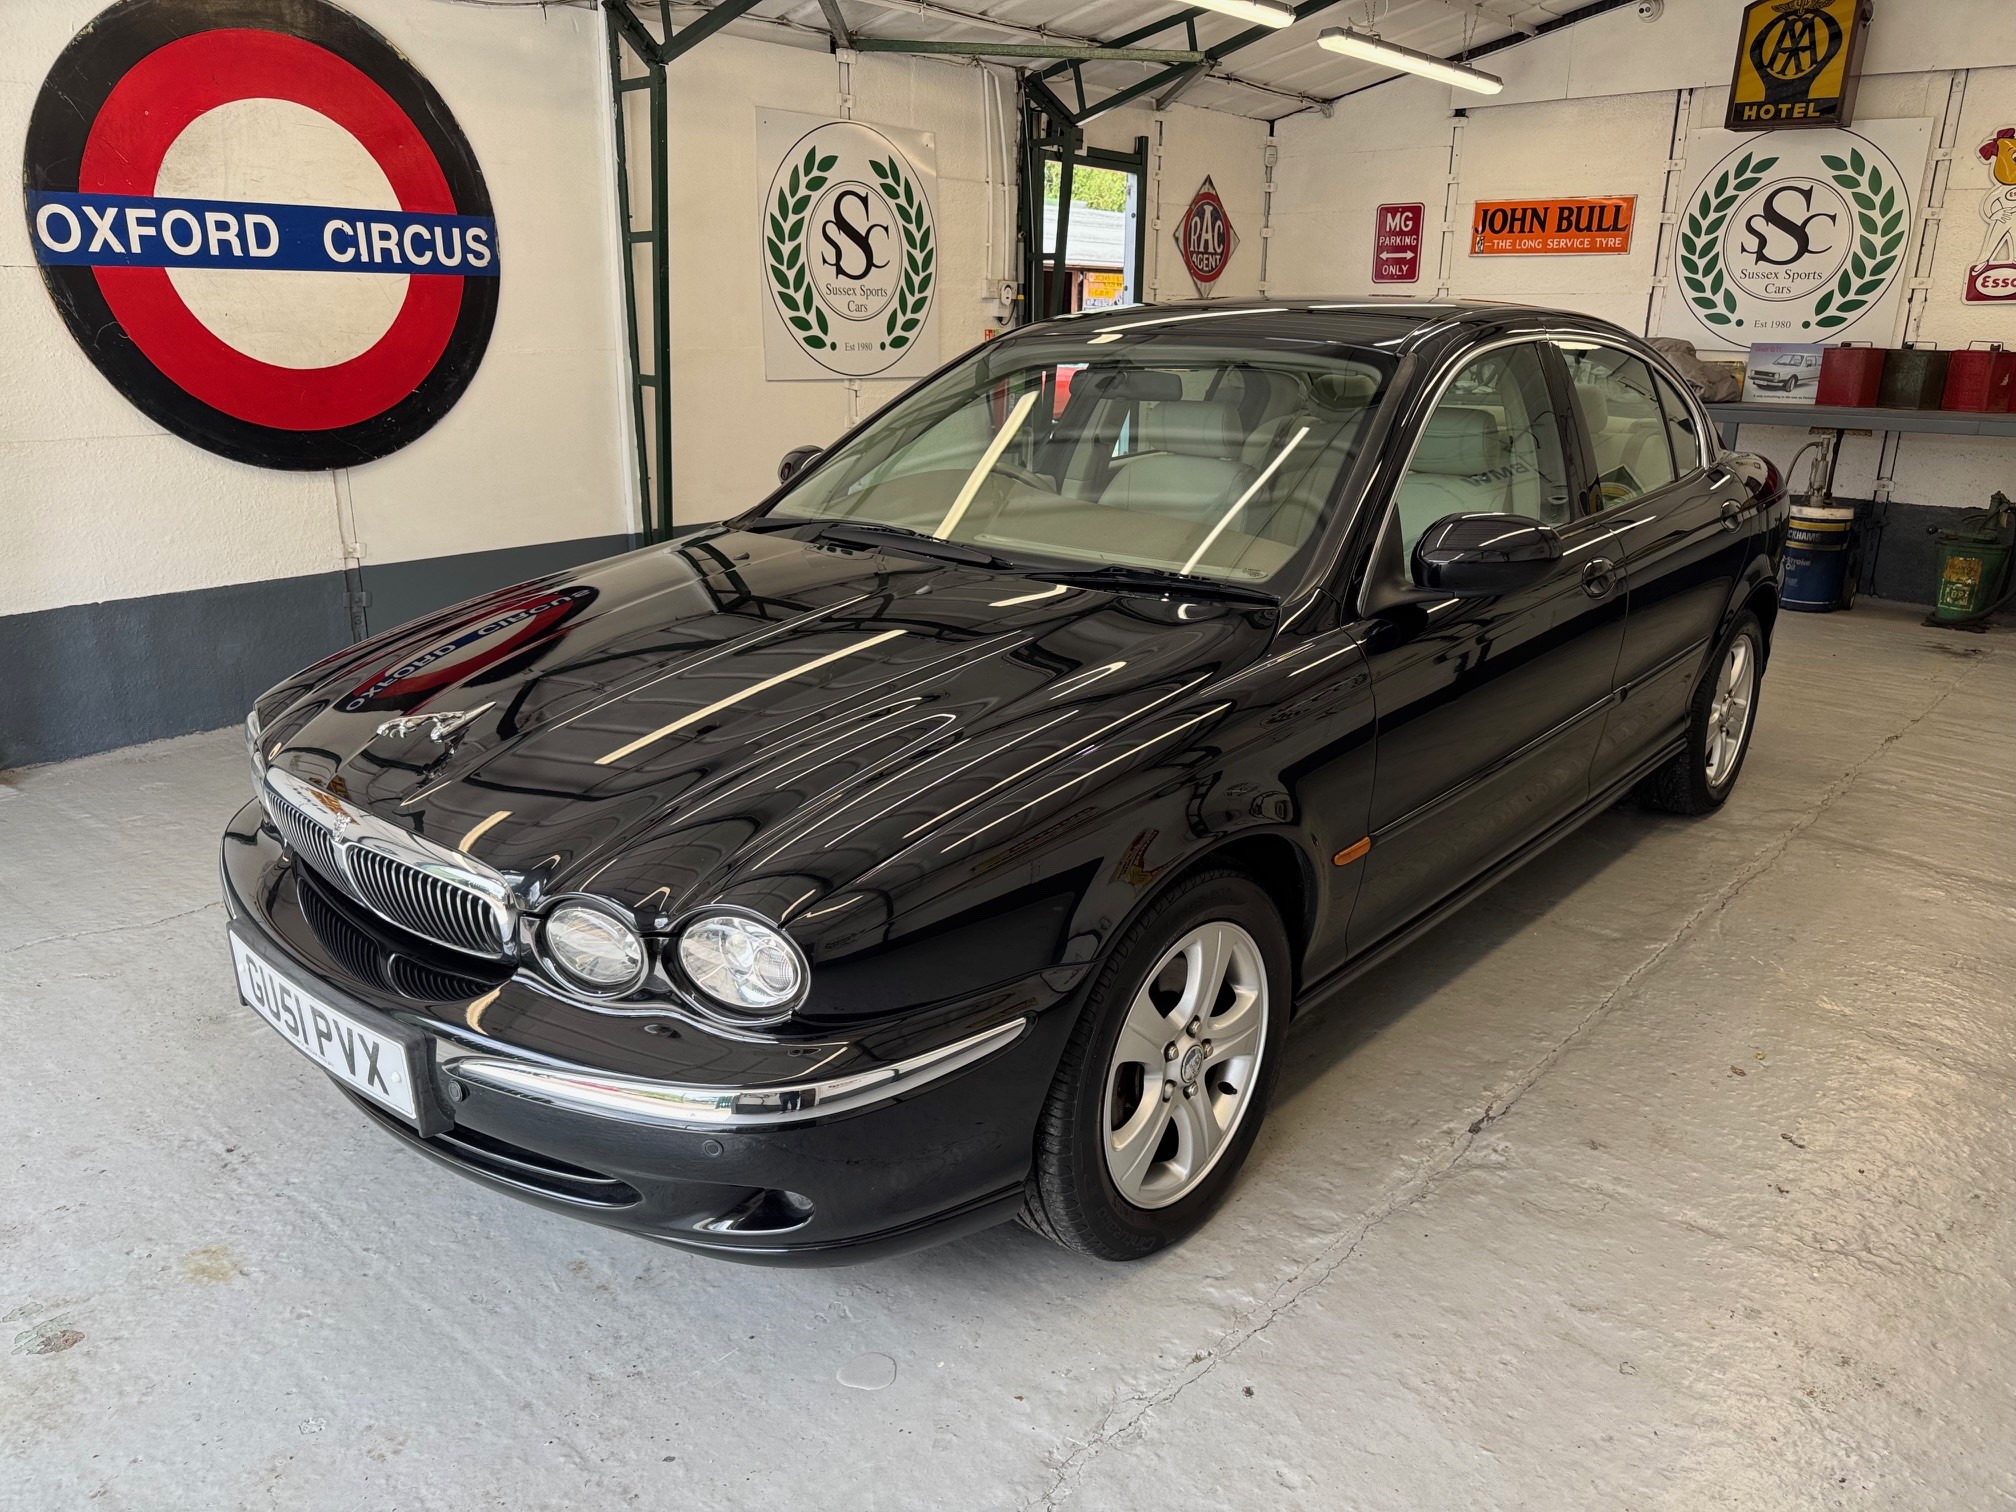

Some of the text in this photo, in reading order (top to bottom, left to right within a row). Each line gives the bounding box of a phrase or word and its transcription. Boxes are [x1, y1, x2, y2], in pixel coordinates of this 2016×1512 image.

[1743, 102, 1820, 120] HOTEL
[1385, 212, 1413, 232] MG
[1474, 204, 1628, 235] JOHN BULL
[36, 203, 493, 267] OXFORD CIRCUS
[1189, 205, 1223, 253] RAC
[1379, 235, 1417, 247] PARKING
[1516, 239, 1542, 249] LONG
[1546, 238, 1591, 249] SERVICE
[1595, 237, 1622, 248] TYRE
[1191, 253, 1222, 271] AGENT
[1382, 264, 1409, 275] ONLY
[1739, 267, 1823, 282] Sussex Sports
[825, 283, 888, 300] Sussex Sports
[1764, 281, 1792, 294] Cars
[847, 300, 868, 313] Cars
[1753, 319, 1791, 329] Est 1980
[844, 342, 873, 351] Est 1980
[310, 1004, 389, 1096] PVX
